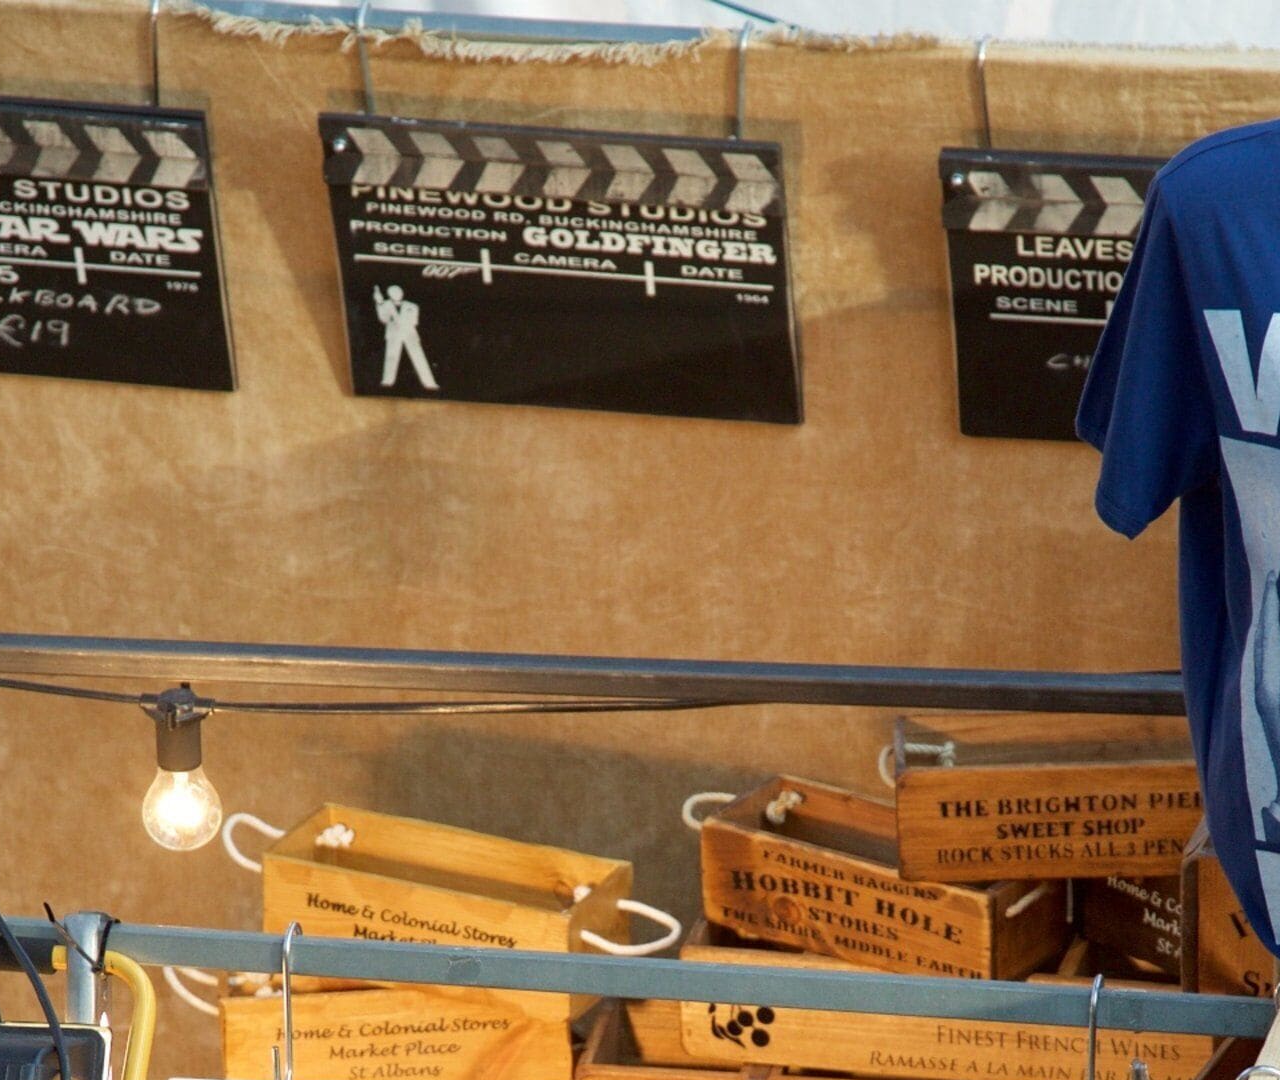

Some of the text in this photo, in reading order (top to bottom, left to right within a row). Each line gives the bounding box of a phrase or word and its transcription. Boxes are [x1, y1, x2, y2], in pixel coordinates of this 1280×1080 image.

[14, 180, 190, 211] STUDIOS
[366, 201, 758, 241] PINEWOOD BUCKINGHAMSHIRE
[73, 220, 203, 253] WARS
[350, 220, 777, 264] PRODUCTION GOLDFINGER
[1017, 236, 1134, 261] LEAVES
[110, 251, 171, 267] DATE
[374, 242, 743, 280] SCENE CAMERA DATE
[165, 282, 199, 292] 1976
[974, 264, 1124, 291] PRODUCTIO
[996, 297, 1077, 313] SCENE
[939, 794, 1138, 819] THE BRIGHTON
[997, 818, 1146, 840] SWEET SHOP
[764, 850, 848, 879] FARMER
[937, 842, 1122, 864] ROCK STICKS ALL
[307, 893, 518, 949] Home Colonial Stores
[730, 869, 964, 946] HOBBIT HOLE
[807, 905, 899, 943] STORES
[834, 934, 907, 964] MIDDLE
[361, 1016, 510, 1038] Colonial Stores
[329, 1041, 461, 1062] Market Place
[372, 1063, 442, 1080] Albans
